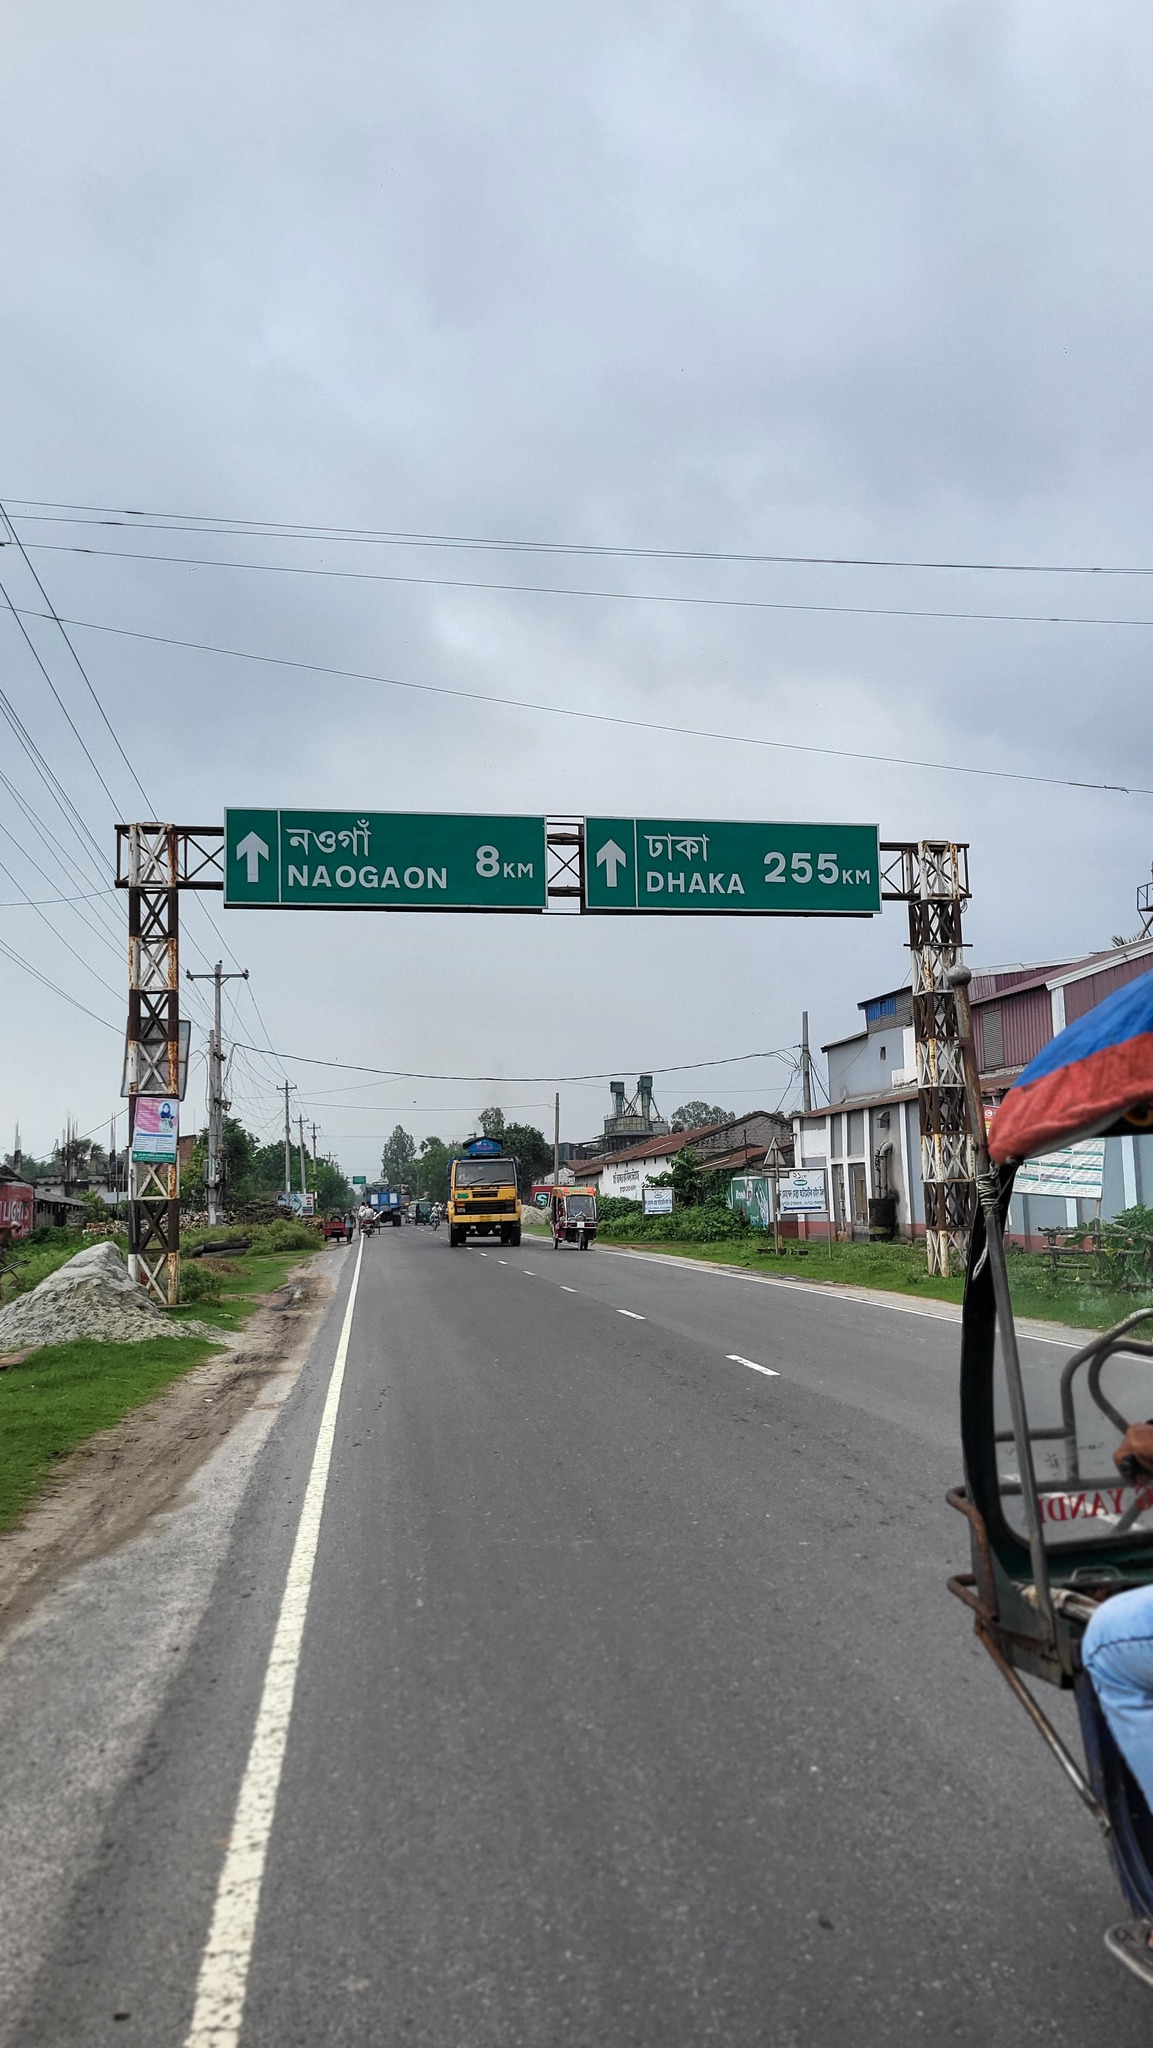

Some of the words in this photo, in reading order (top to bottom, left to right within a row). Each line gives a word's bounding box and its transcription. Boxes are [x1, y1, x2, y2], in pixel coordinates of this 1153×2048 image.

[285, 818, 372, 857] নওগাঁ
[643, 832, 710, 862] ঢাকা
[288, 864, 447, 889] NAOGAON
[646, 871, 745, 895] DHAKA
